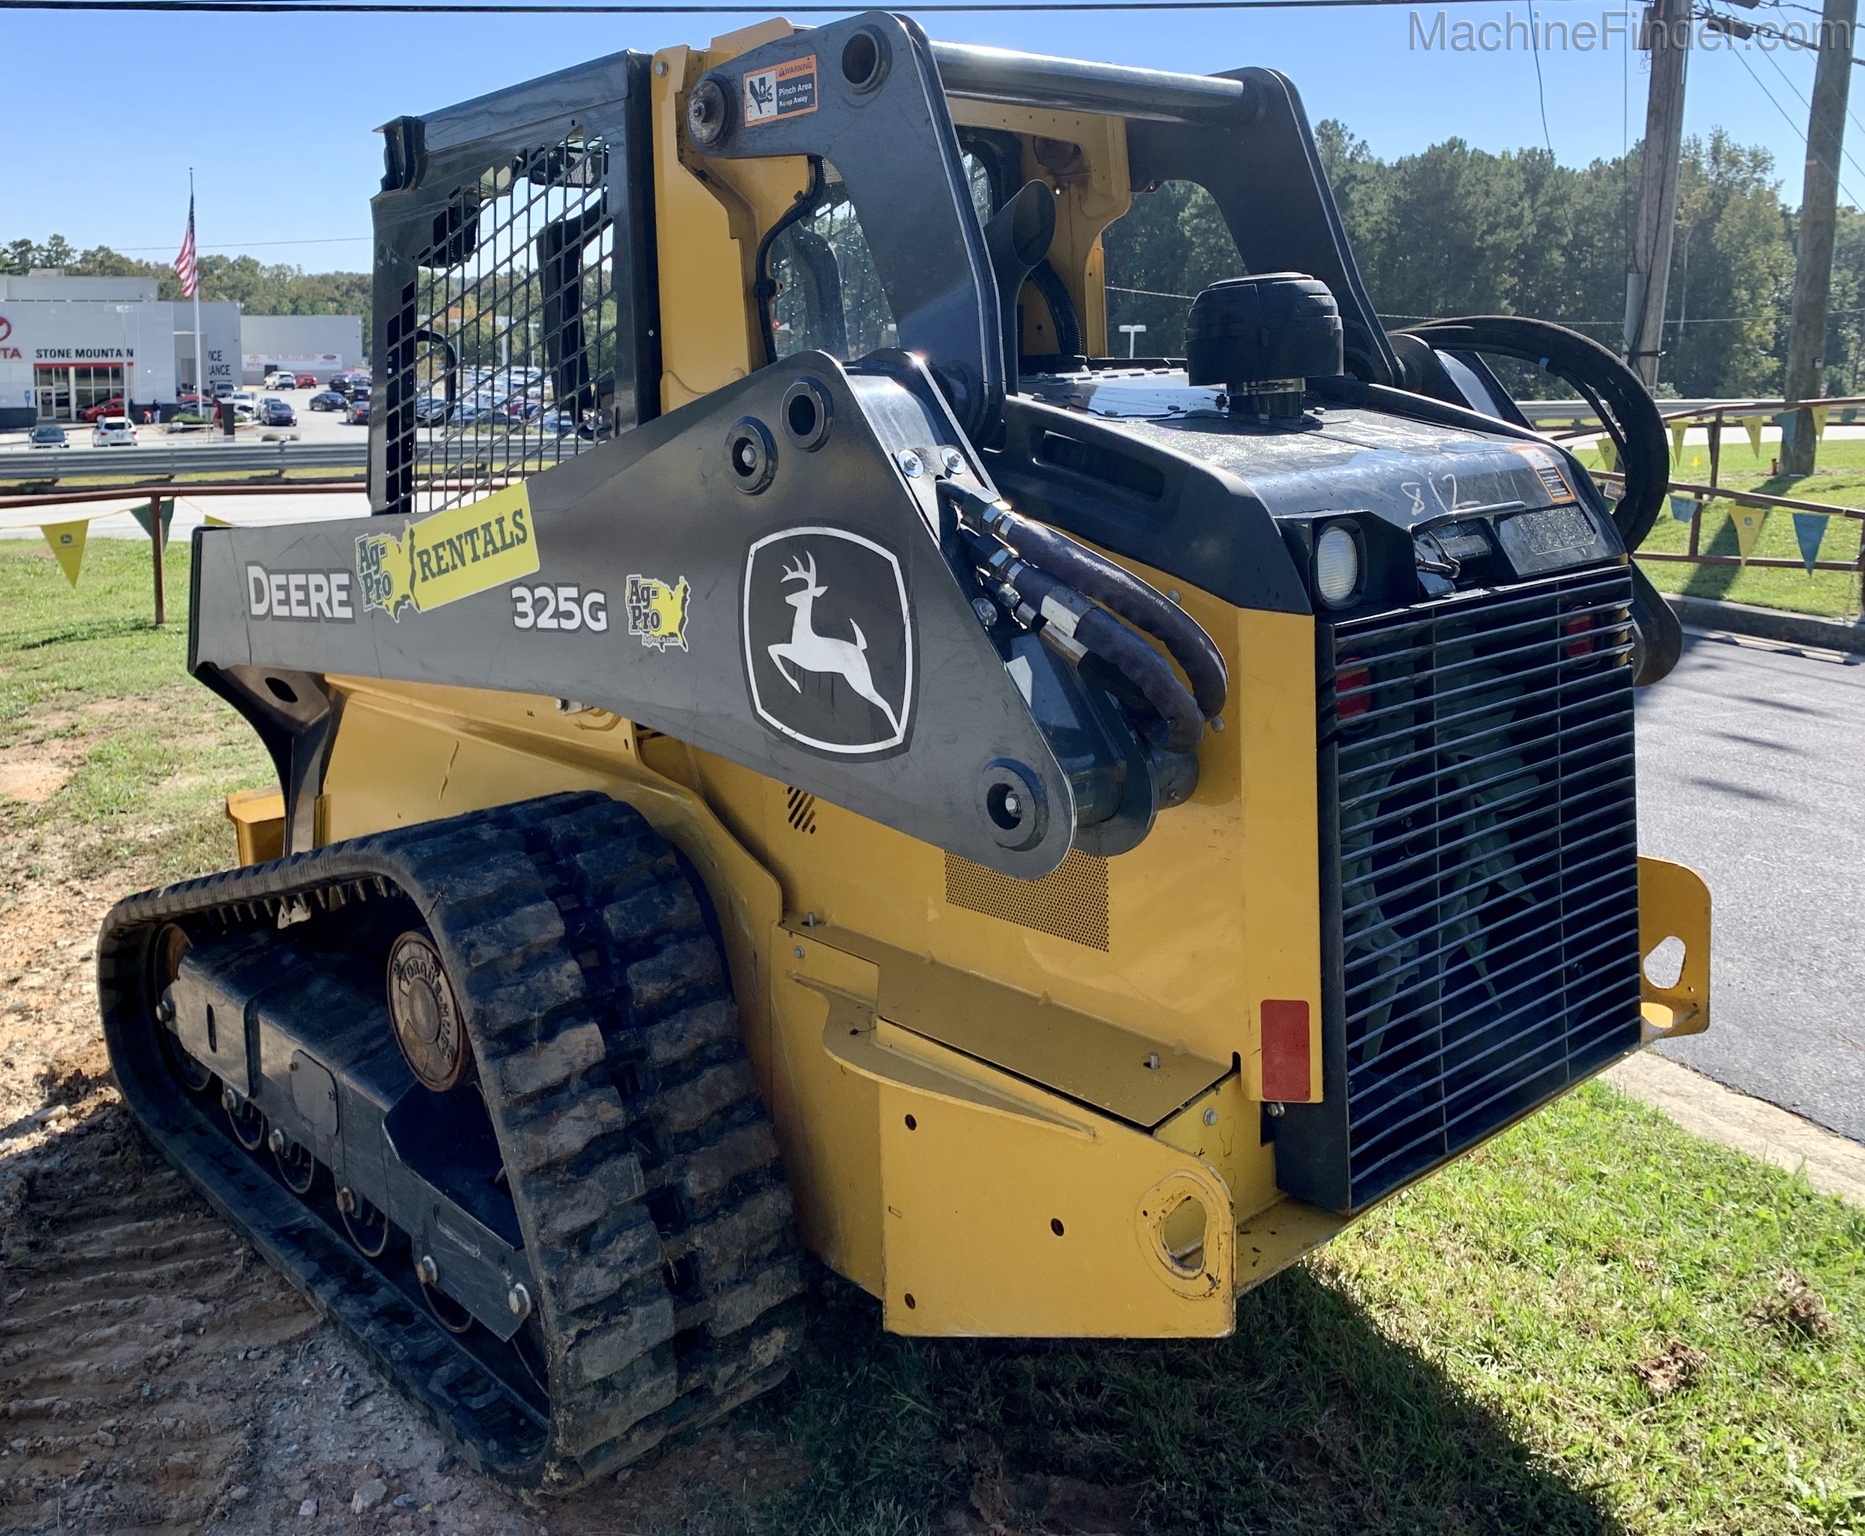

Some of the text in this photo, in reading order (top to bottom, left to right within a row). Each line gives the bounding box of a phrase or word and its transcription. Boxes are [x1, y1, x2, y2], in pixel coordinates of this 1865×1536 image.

[785, 62, 813, 75] WARNING
[779, 83, 812, 97] Pinch Area
[779, 96, 808, 107] Keep Away
[36, 348, 134, 359] STONE MOUNTAN
[416, 508, 528, 583] RENTALS
[247, 565, 354, 620] DEERE
[361, 572, 392, 606] Pro
[511, 586, 608, 632] 325G
[630, 605, 661, 630] Pro
